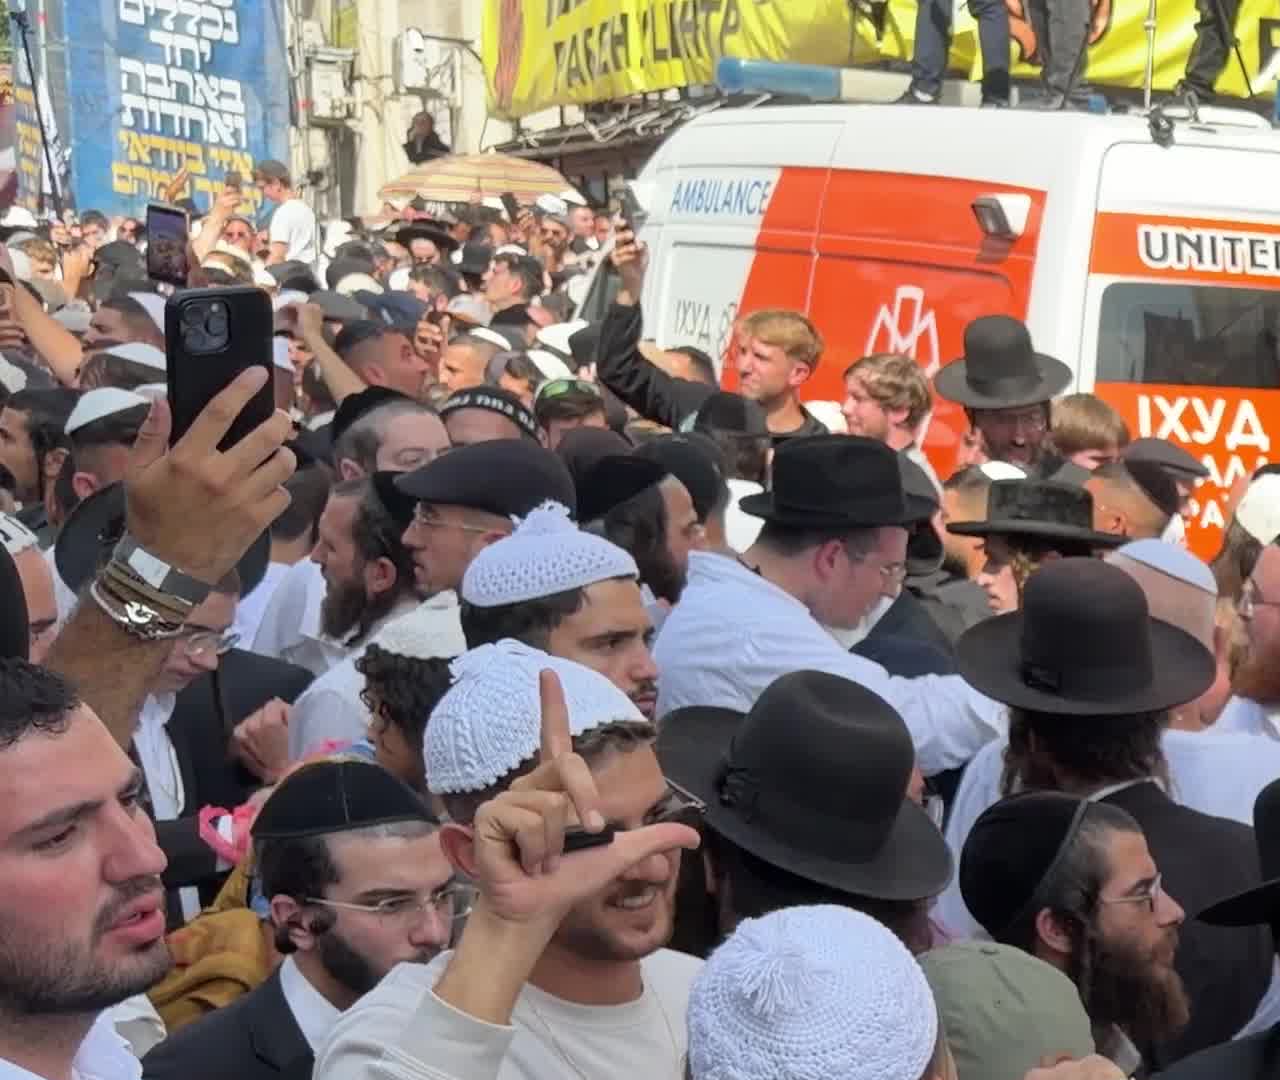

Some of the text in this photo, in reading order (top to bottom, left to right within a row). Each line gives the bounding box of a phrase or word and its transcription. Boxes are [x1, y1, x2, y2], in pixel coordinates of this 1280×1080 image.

[149, 29, 213, 71] יחד
[119, 56, 245, 114] באהבה
[120, 93, 248, 149] ואחדות
[670, 179, 772, 217] AMBULANCE
[1137, 394, 1271, 453] ІХУД
